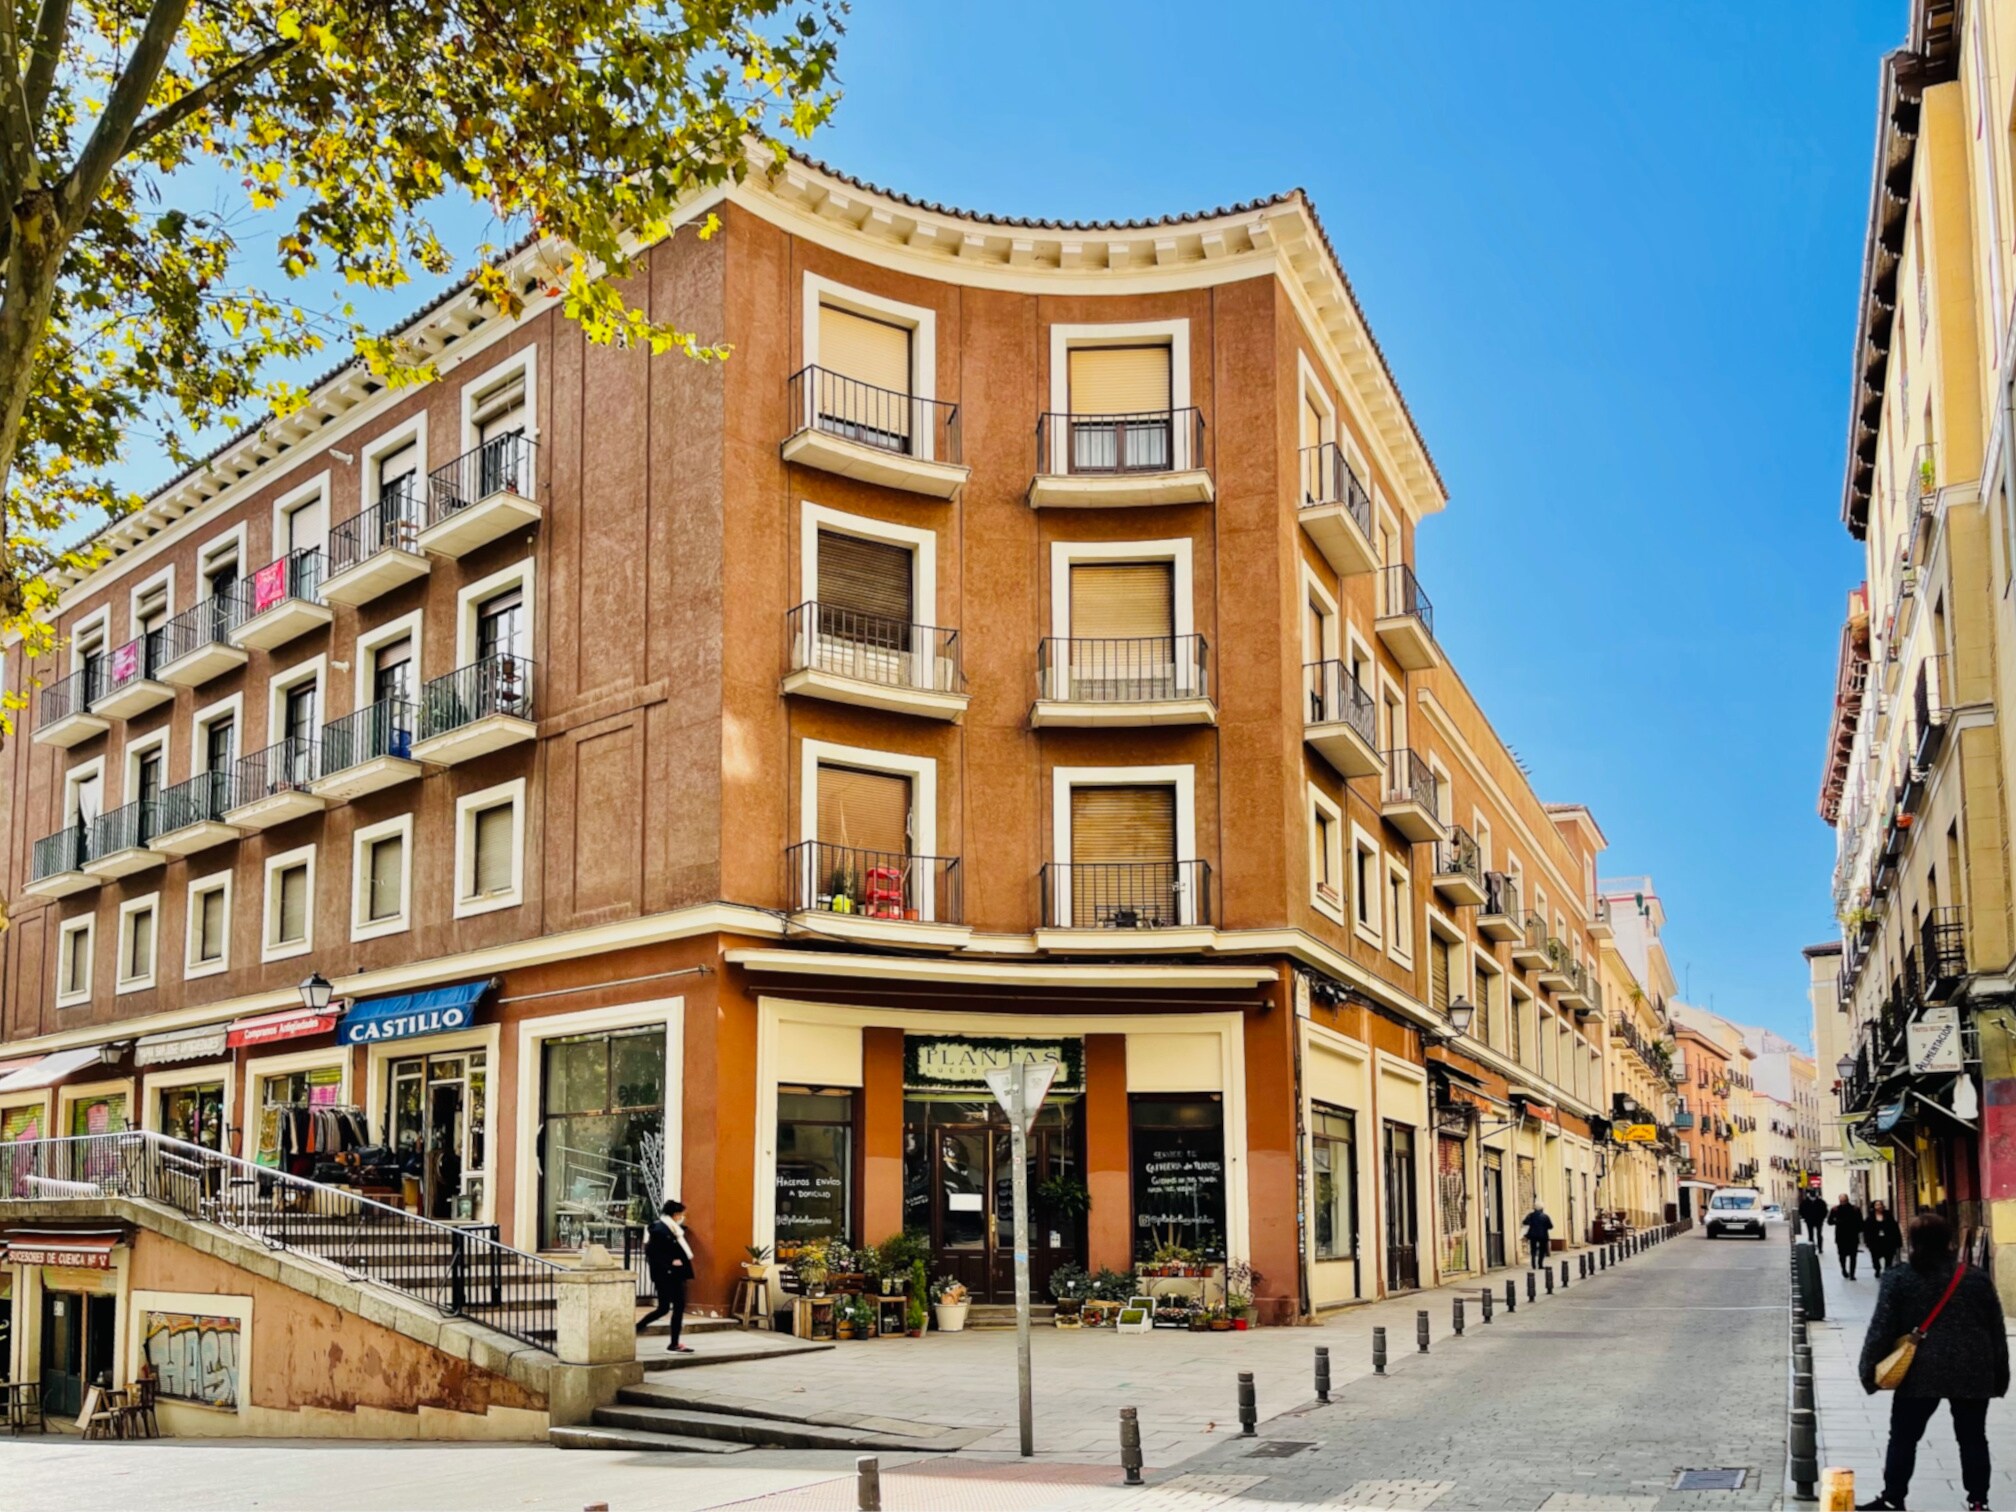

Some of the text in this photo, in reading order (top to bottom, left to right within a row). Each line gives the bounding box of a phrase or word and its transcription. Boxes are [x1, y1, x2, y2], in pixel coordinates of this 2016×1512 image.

[349, 1008, 464, 1041] CASTILLO
[244, 1026, 277, 1041] Compramos
[926, 1050, 1060, 1066] PLANTAS
[9, 1251, 45, 1263] SUCESORES
[47, 1252, 57, 1264] DE
[58, 1253, 85, 1265] CUENCA
